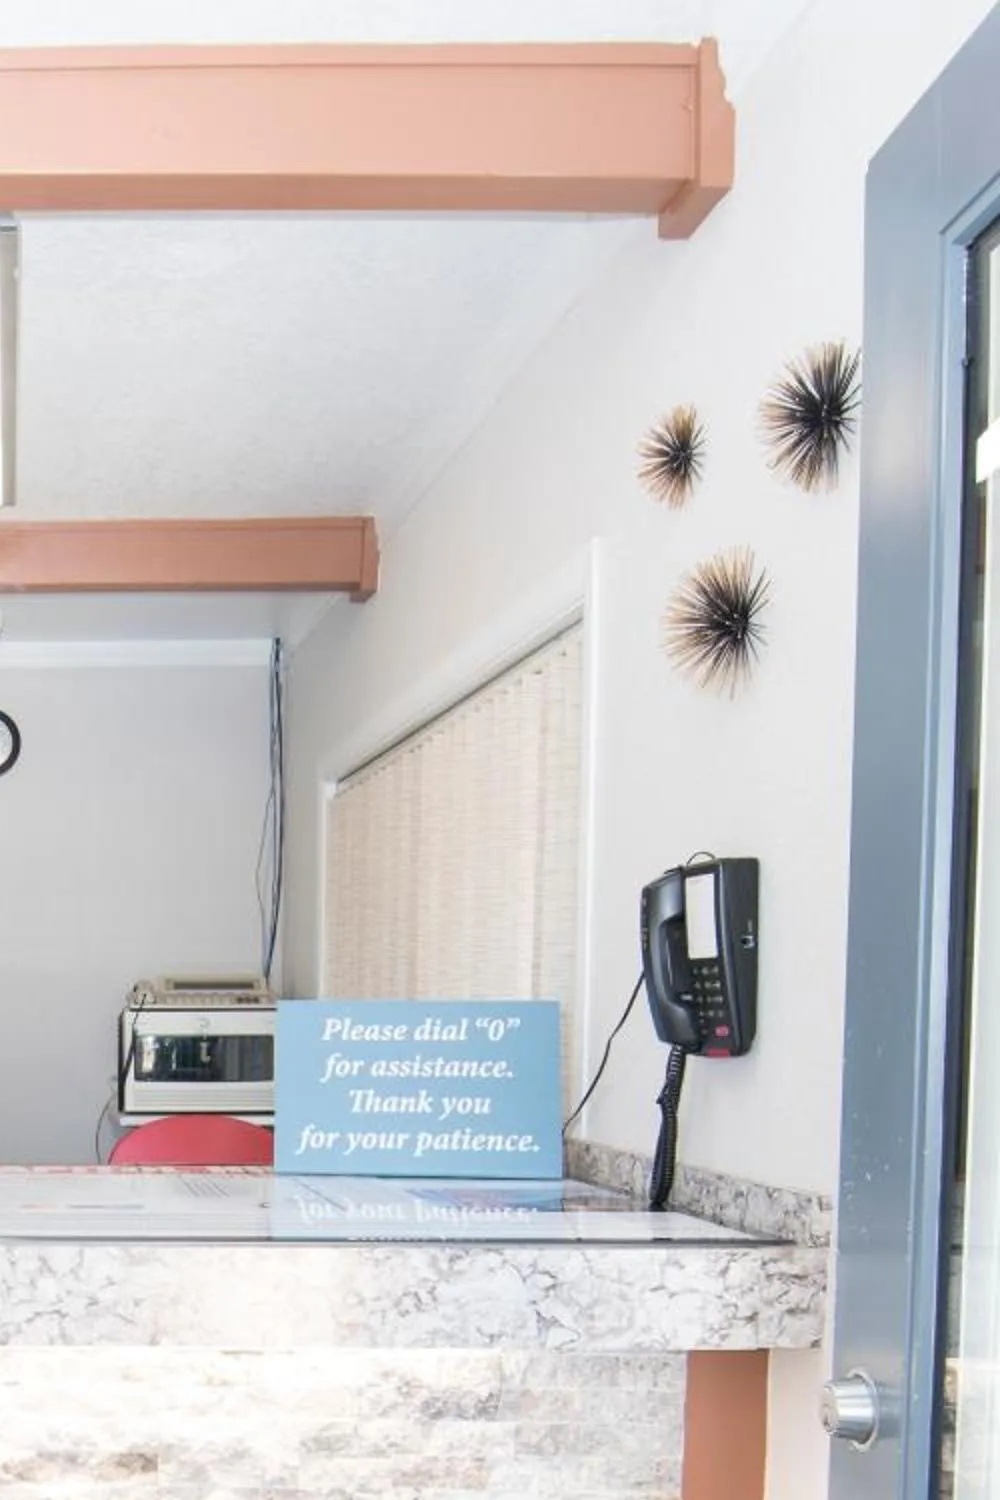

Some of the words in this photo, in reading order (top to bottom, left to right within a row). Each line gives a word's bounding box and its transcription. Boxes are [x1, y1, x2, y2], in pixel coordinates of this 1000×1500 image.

[321, 1018, 408, 1042] Please
[413, 1018, 468, 1042] dial
[319, 1052, 366, 1083] for
[370, 1055, 514, 1079] assistance.
[348, 1089, 433, 1114] Thank
[438, 1098, 492, 1121] you
[295, 1124, 341, 1155] for
[344, 1132, 410, 1156] your
[412, 1129, 541, 1157] patience.
